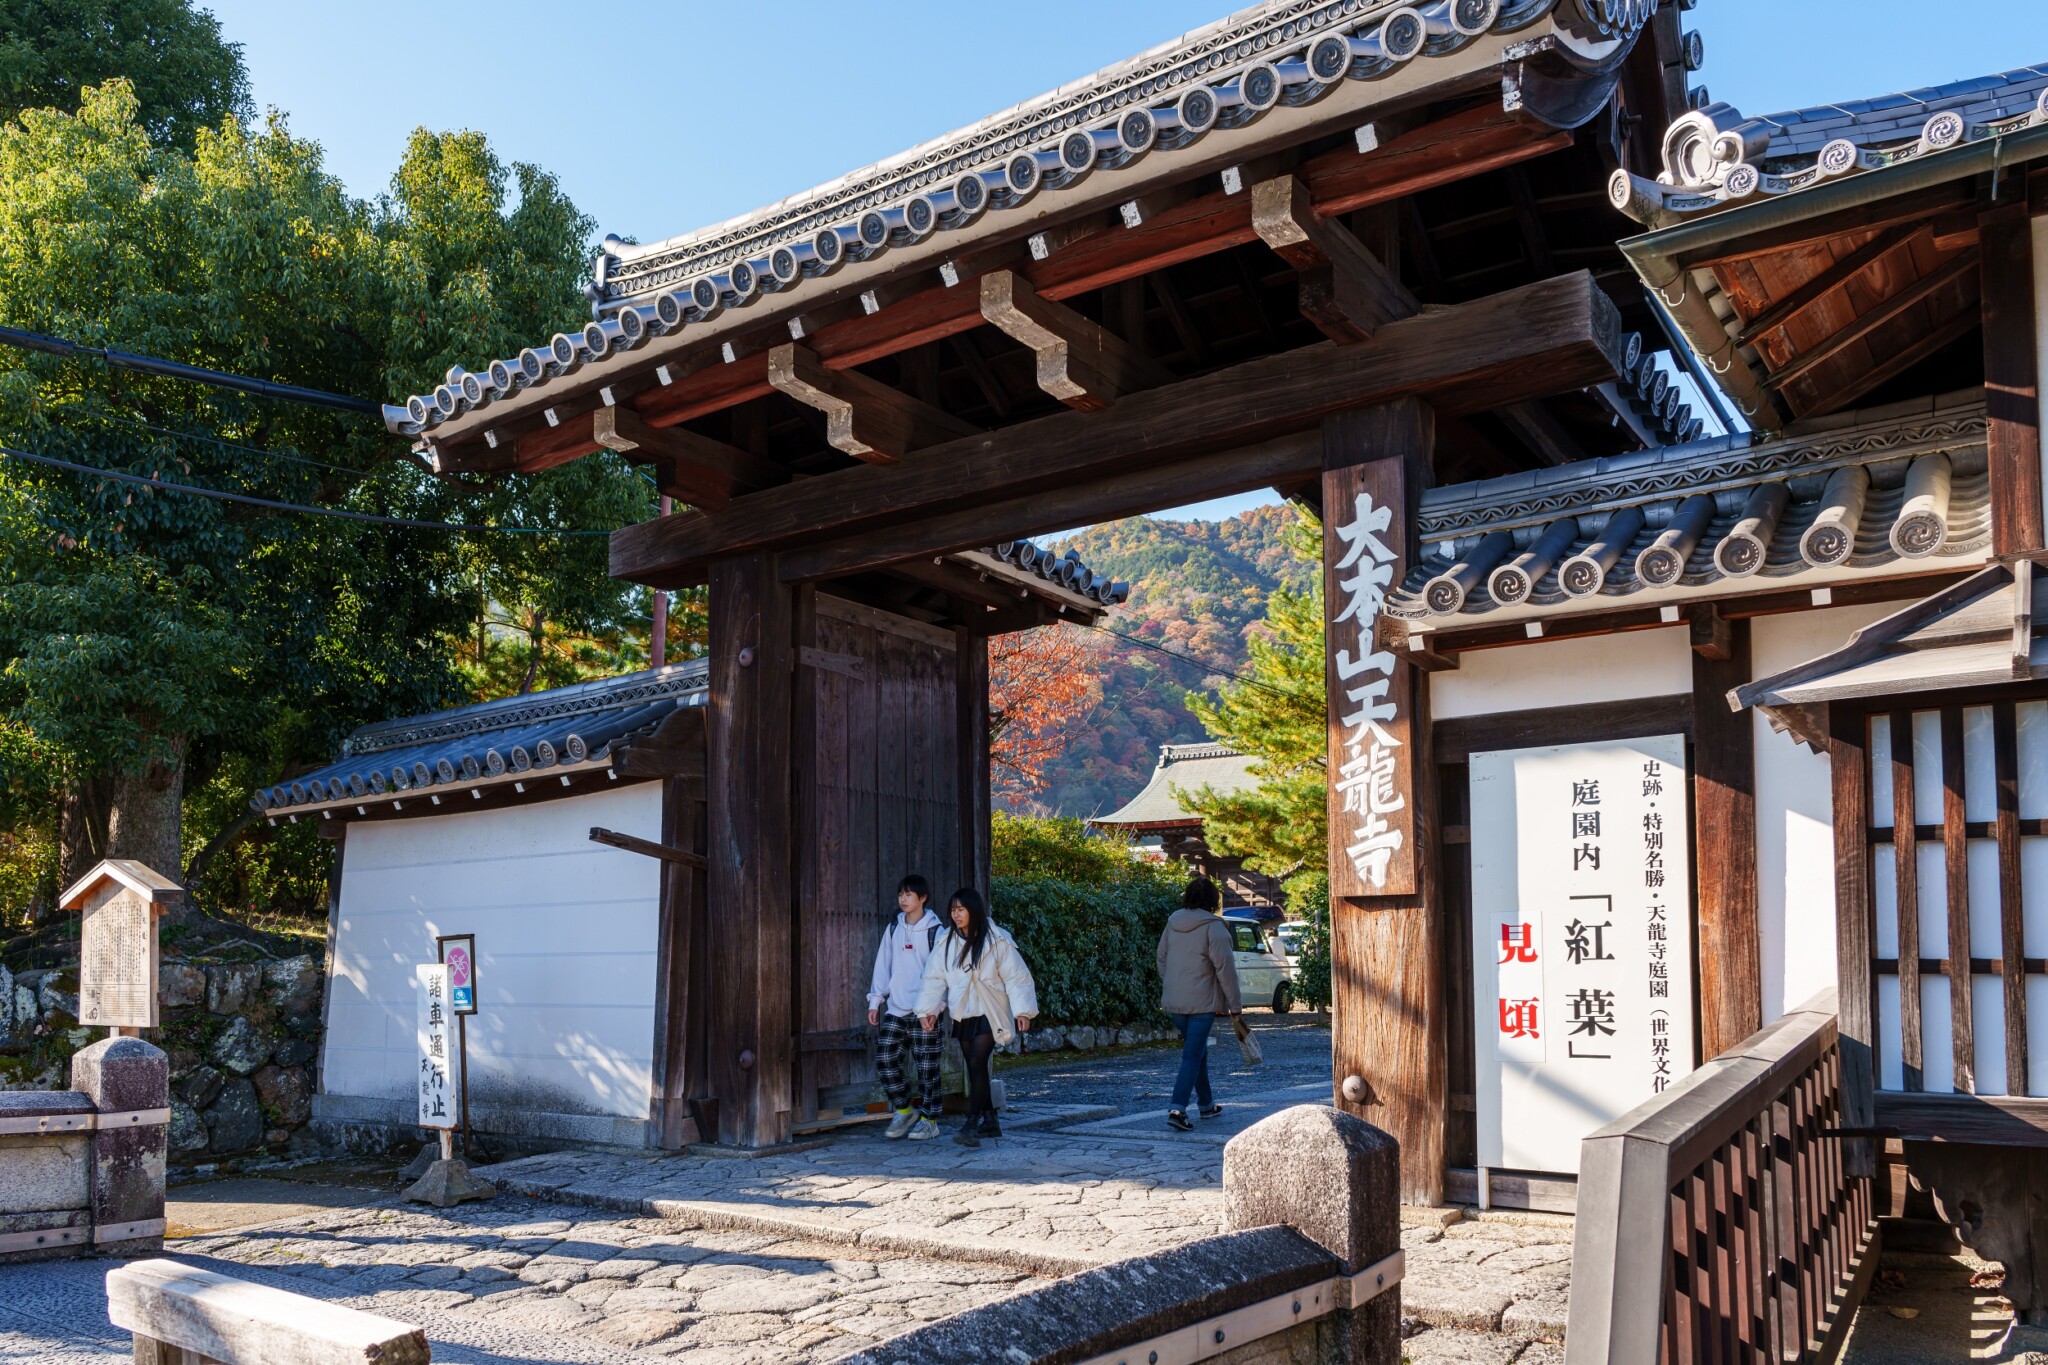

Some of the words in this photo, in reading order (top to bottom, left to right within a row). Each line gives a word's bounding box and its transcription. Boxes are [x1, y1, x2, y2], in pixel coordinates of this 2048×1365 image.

[1333, 492, 1405, 888] 大本山天龍寺
[429, 974, 447, 1118] 諸車通行止
[1497, 922, 1541, 1040] 見頃
